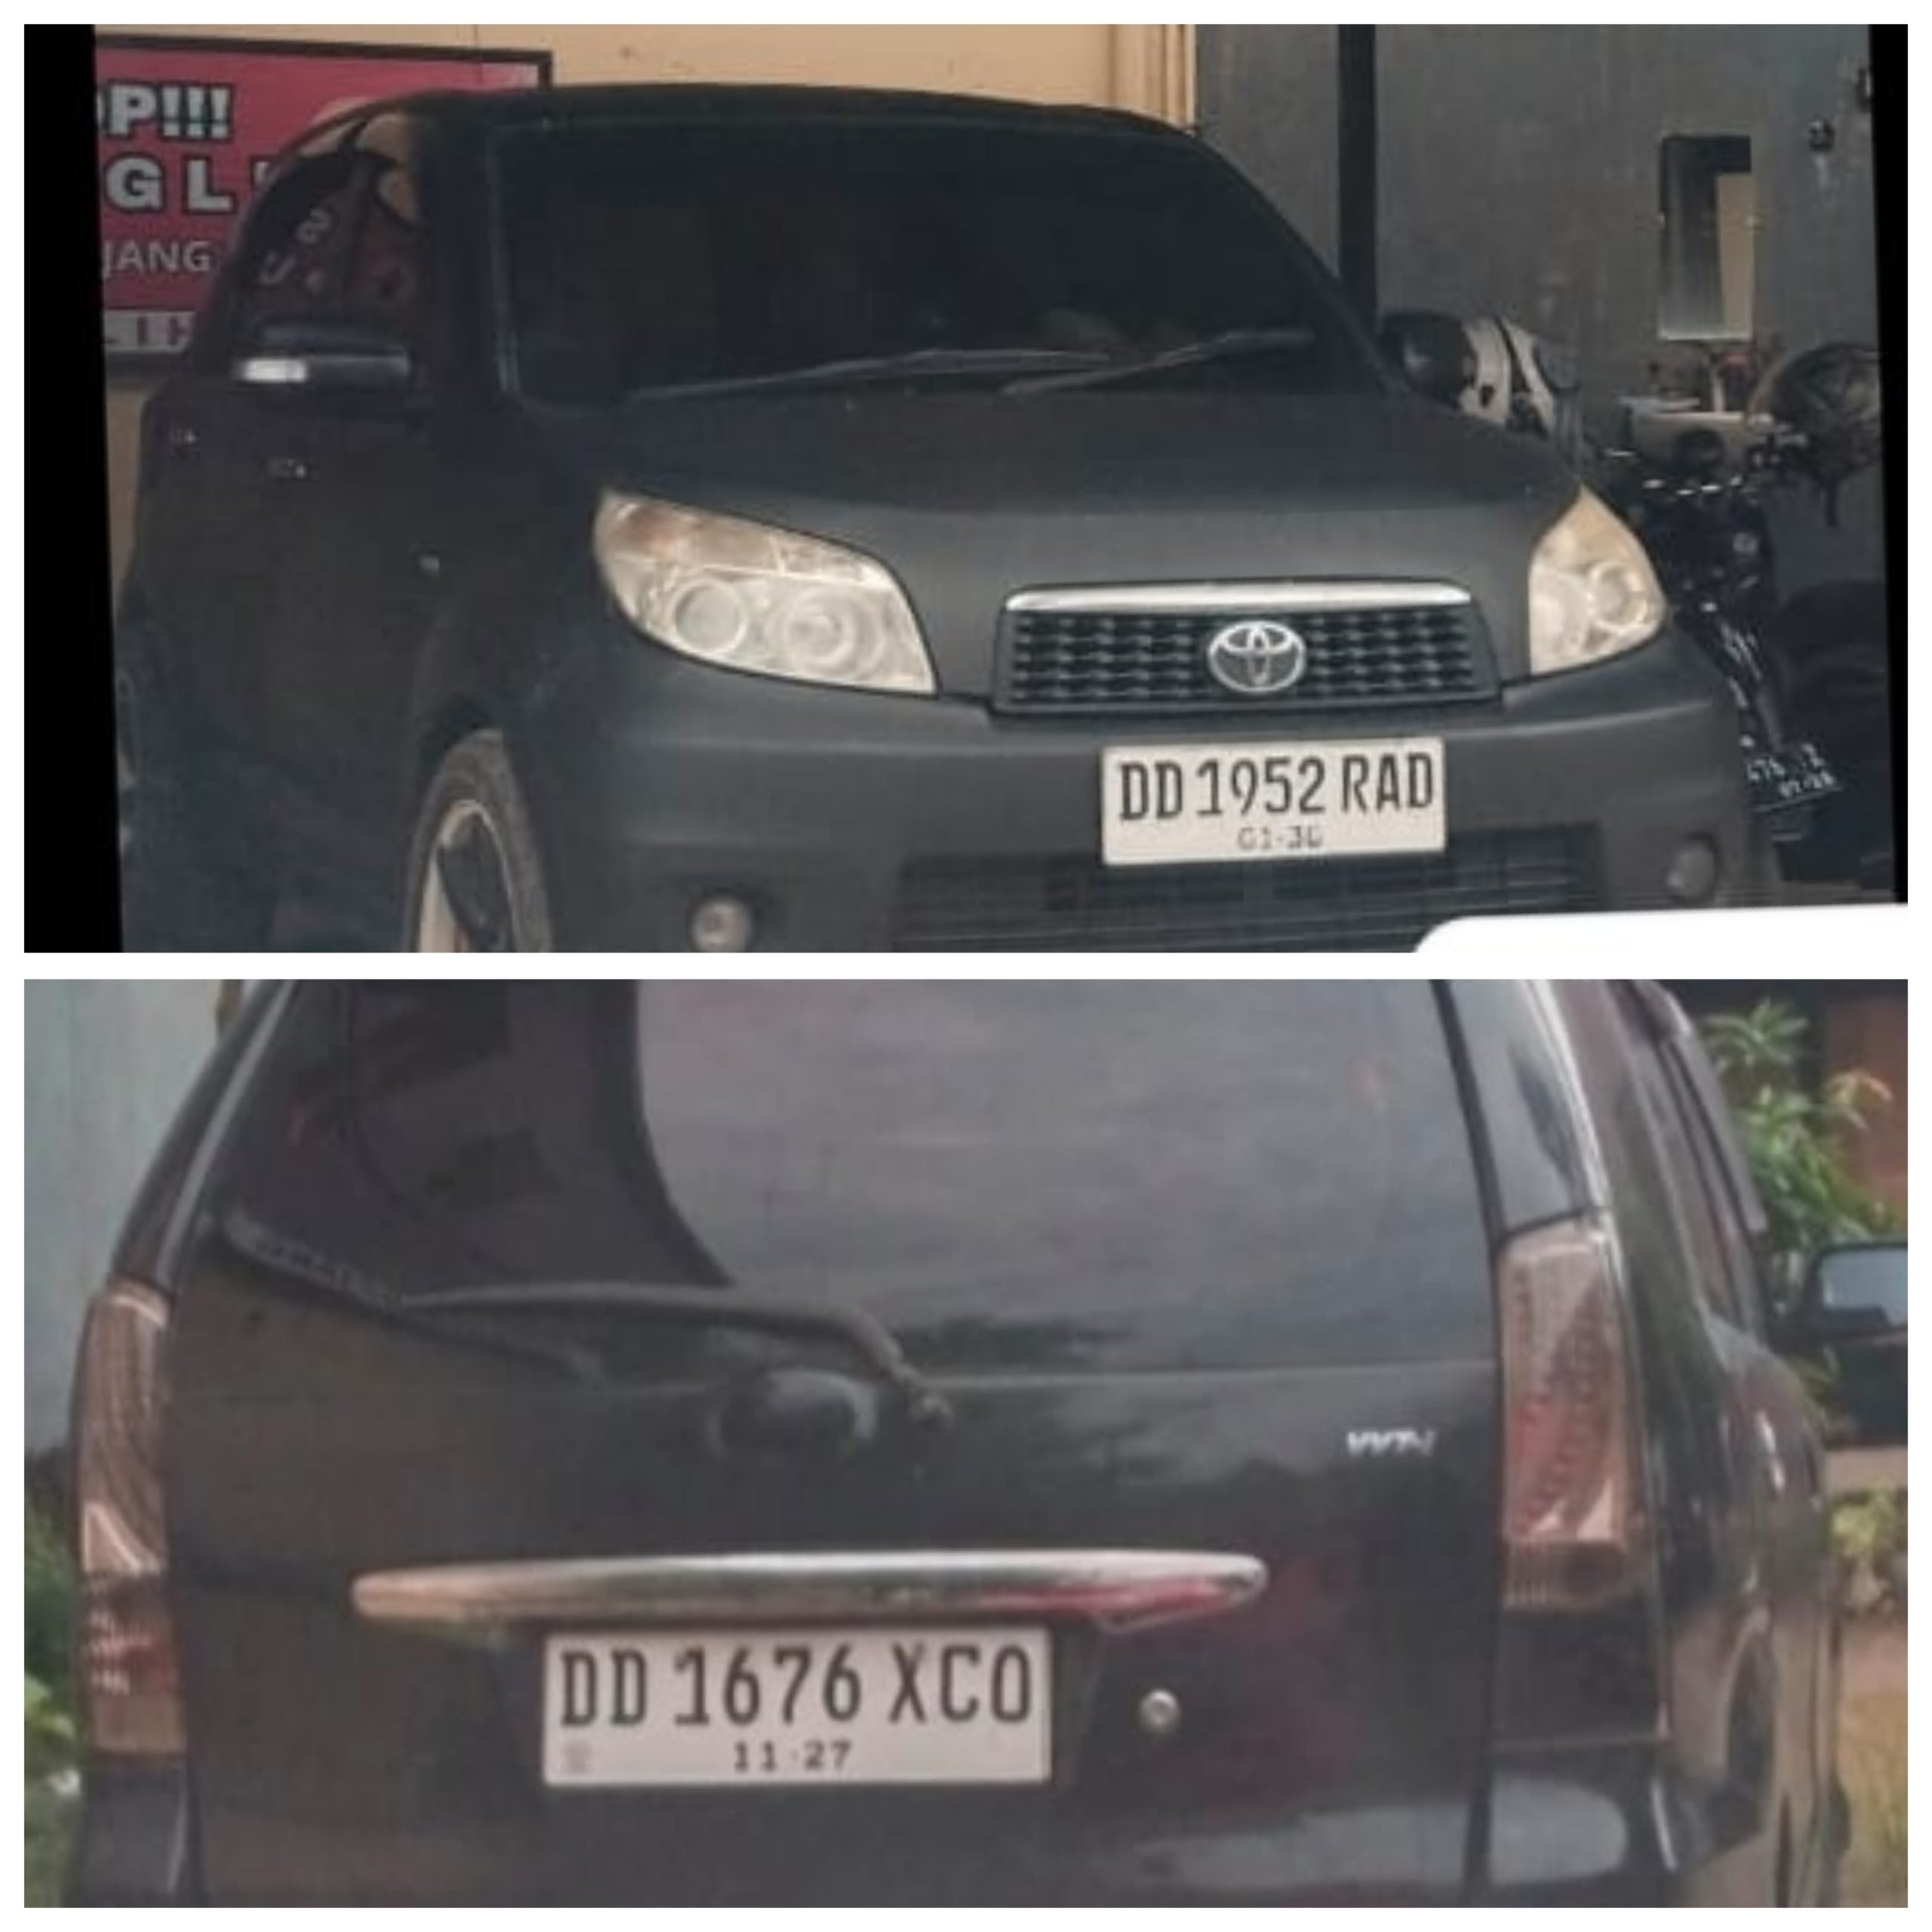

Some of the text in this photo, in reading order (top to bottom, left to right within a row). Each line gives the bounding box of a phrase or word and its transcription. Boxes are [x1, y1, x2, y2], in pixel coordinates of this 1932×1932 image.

[1120, 751, 1433, 820] DD 1952 RAD
[561, 1642, 1032, 1726] DD 1676 XCO
